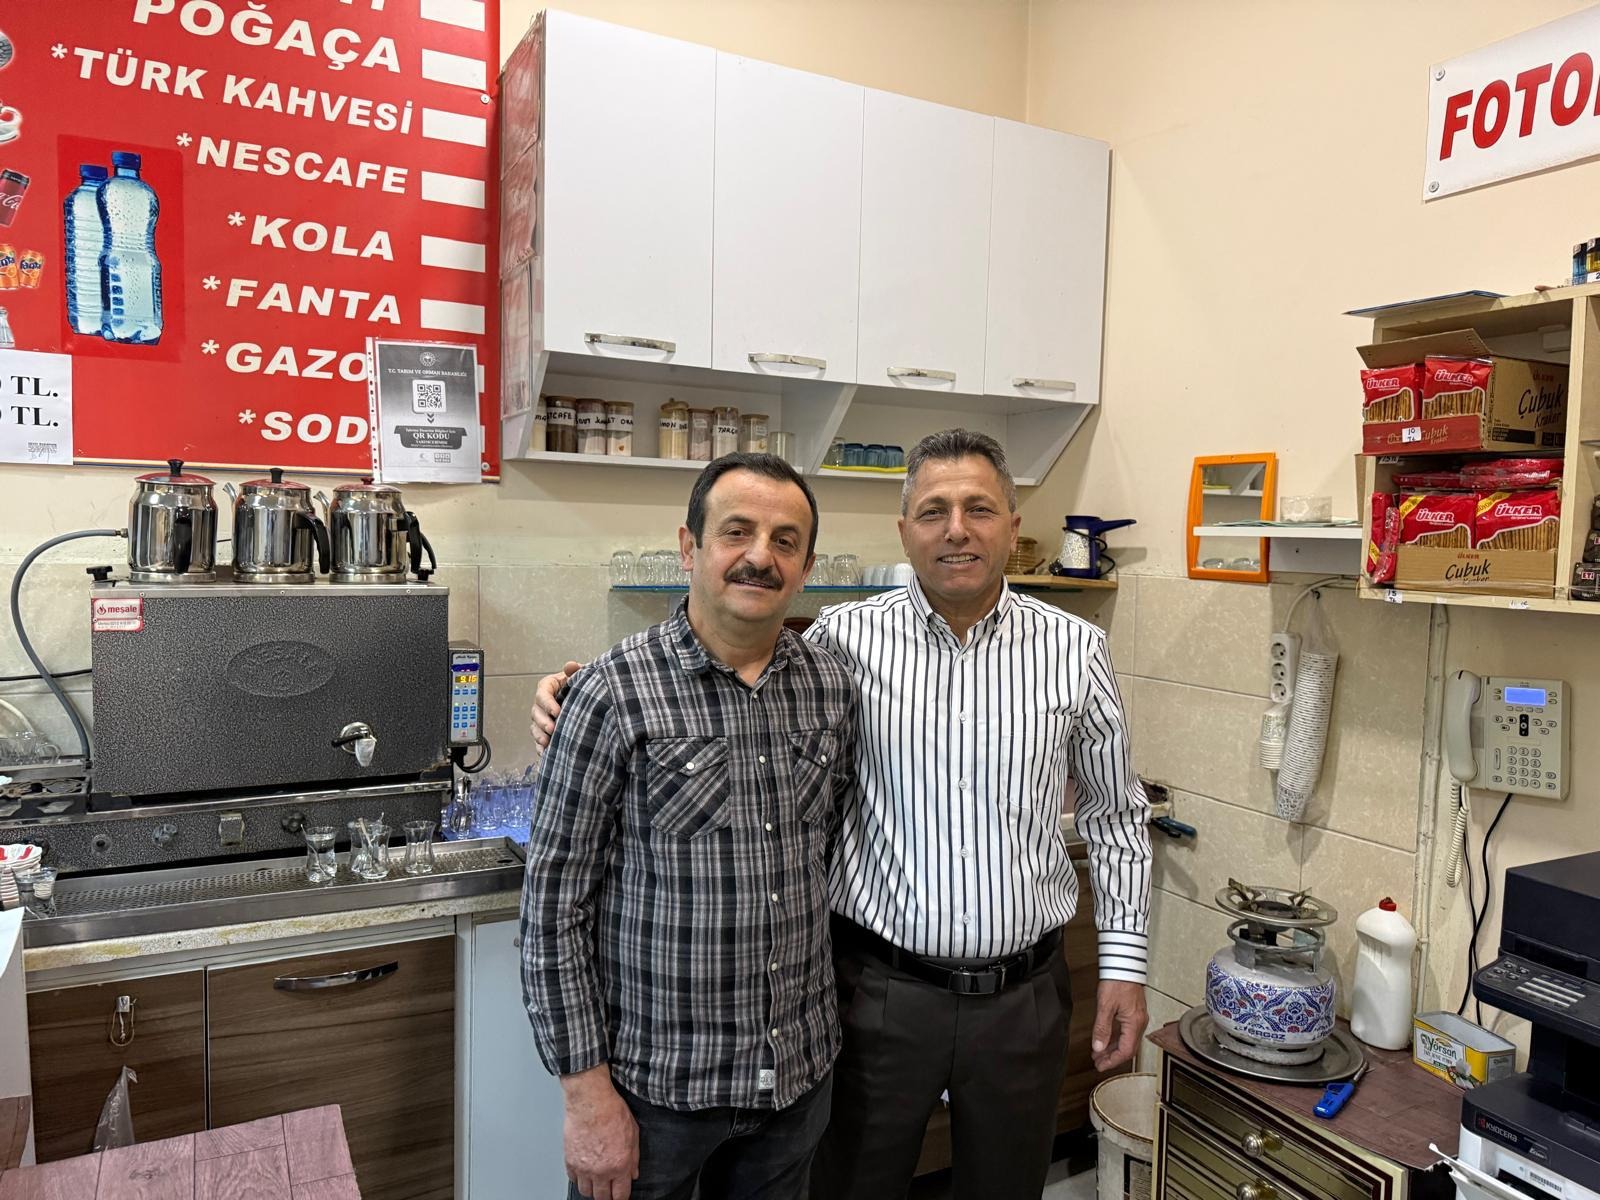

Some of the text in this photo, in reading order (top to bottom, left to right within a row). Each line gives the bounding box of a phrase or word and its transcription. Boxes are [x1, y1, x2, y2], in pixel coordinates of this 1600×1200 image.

[133, 0, 401, 73] POĞAÇA
[73, 46, 413, 135] TÜRK KAHVESİ
[1439, 51, 1600, 161] FOTO
[196, 135, 408, 195] NESCAFE
[250, 214, 395, 261] KOLA
[225, 278, 401, 325] FANTA
[225, 342, 369, 382] GAZO
[11, 375, 59, 397] TL.
[11, 405, 59, 427] TL.
[260, 411, 373, 445] SOD
[413, 432, 426, 441] QR
[1416, 508, 1454, 522] ÜLKER
[1495, 503, 1542, 517] ÜLKER
[1428, 1036, 1457, 1060] Yörsan
[1486, 1121, 1518, 1143] KYOCERA
